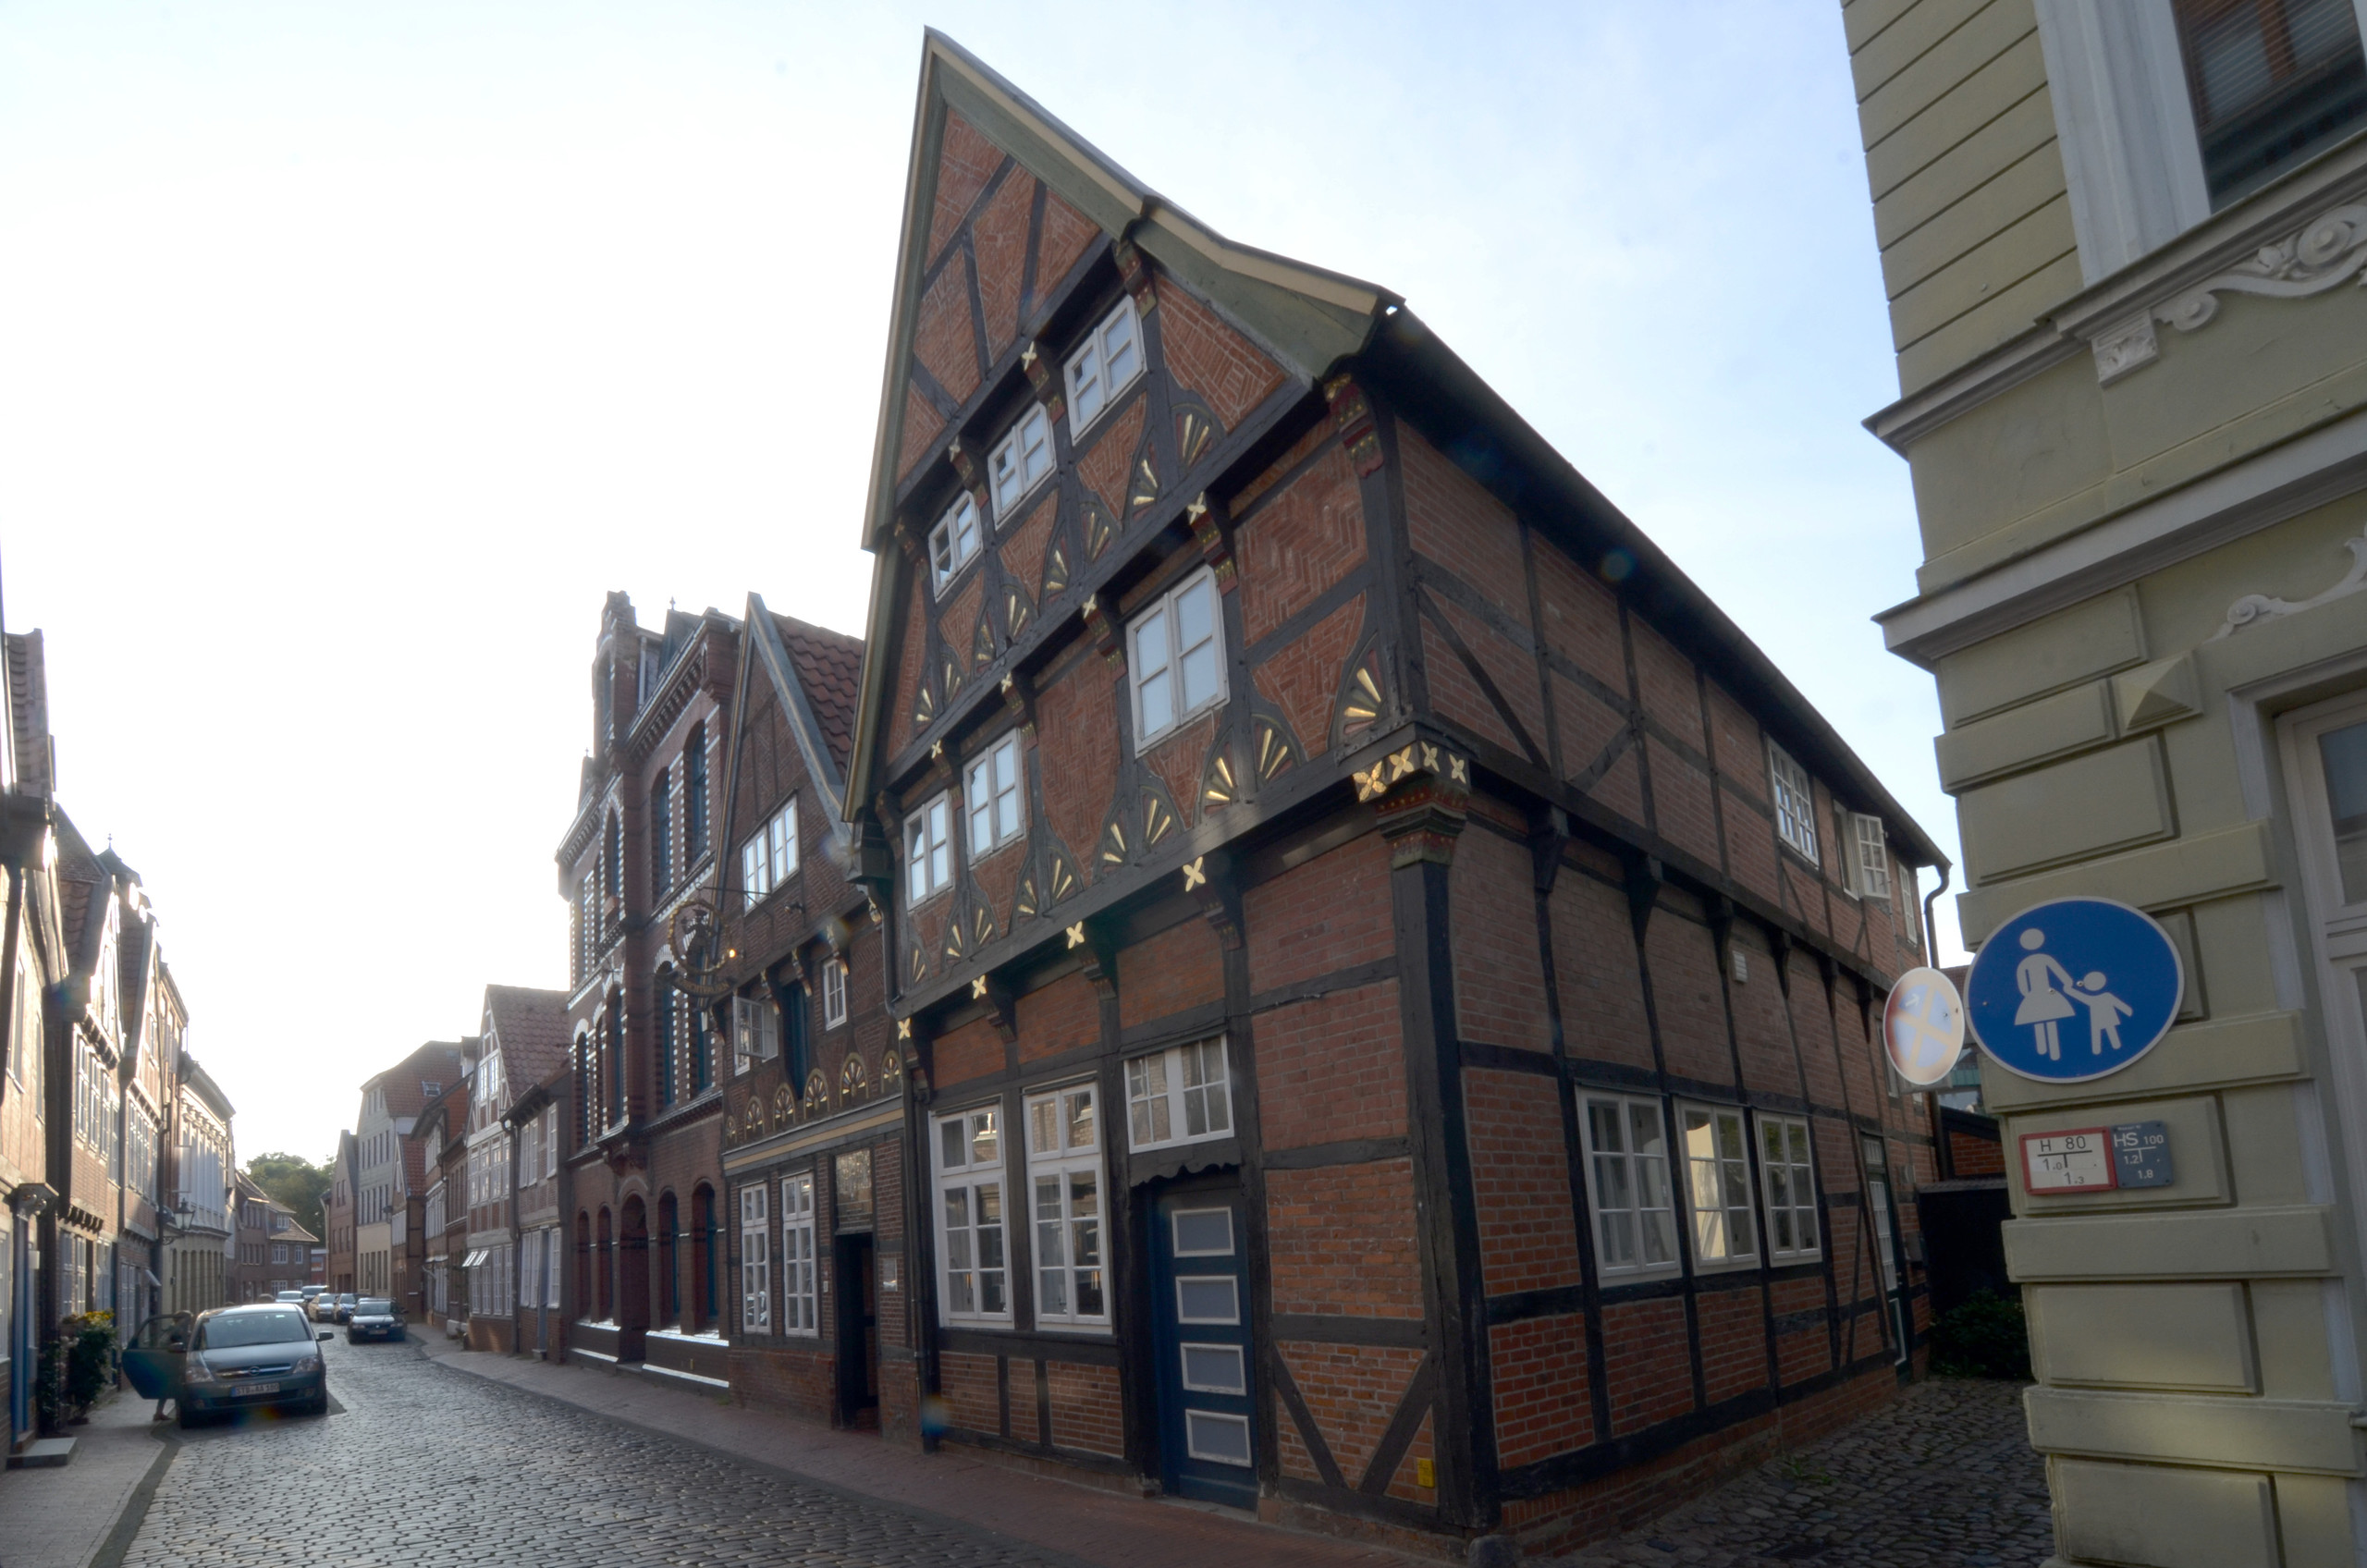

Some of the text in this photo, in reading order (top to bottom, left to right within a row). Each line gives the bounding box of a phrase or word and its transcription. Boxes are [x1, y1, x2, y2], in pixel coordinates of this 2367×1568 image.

[2040, 1135, 2086, 1152] H 80
[2114, 1133, 2165, 1147] HS 100
[2042, 1158, 2063, 1171] 1.0
[2124, 1155, 2140, 1165] 1.2
[2064, 1171, 2085, 1184] 1.3
[2138, 1169, 2153, 1179] 1.8
